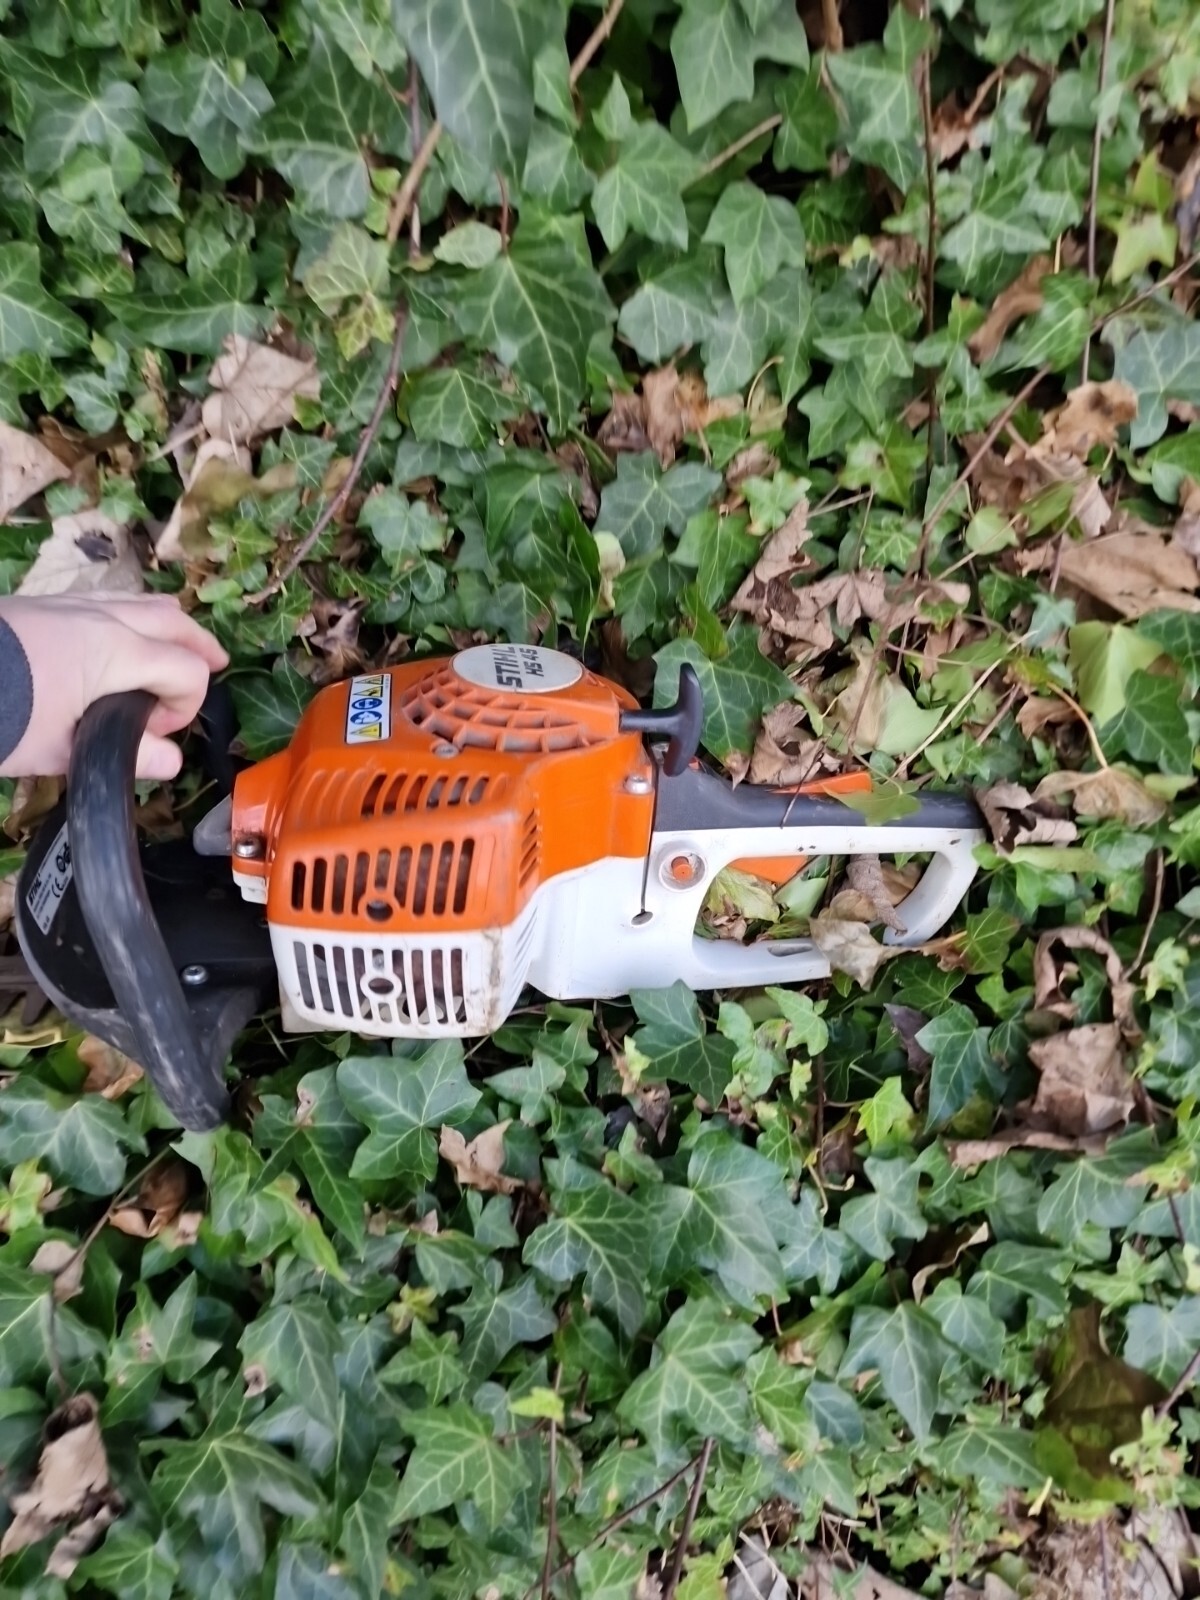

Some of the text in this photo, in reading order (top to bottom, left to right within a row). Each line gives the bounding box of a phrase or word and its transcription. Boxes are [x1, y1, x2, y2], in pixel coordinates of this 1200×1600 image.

[492, 646, 523, 688] STIHL
[519, 648, 544, 677] HS 45
